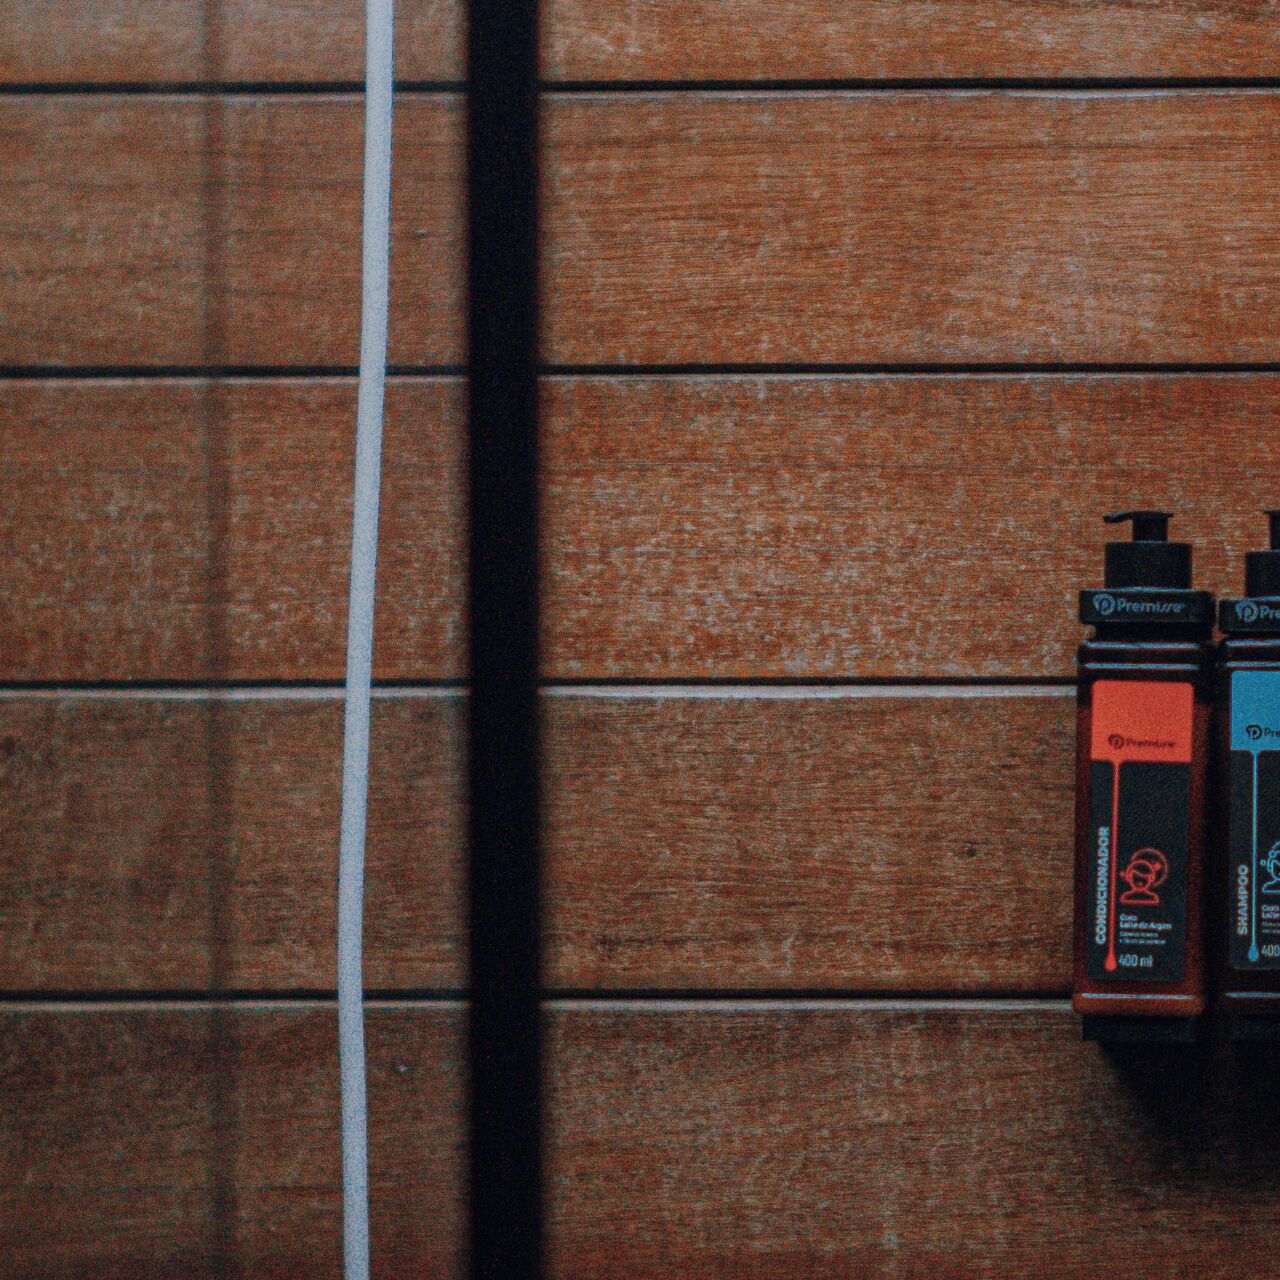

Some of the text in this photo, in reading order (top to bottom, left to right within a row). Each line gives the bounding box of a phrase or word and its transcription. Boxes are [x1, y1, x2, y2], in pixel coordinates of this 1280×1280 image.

[1095, 826, 1110, 945] CONDICIONADOR
[1237, 864, 1249, 936] SHAMPOO
[1119, 954, 1153, 967] 400 ml
[1262, 944, 1280, 957] 400
